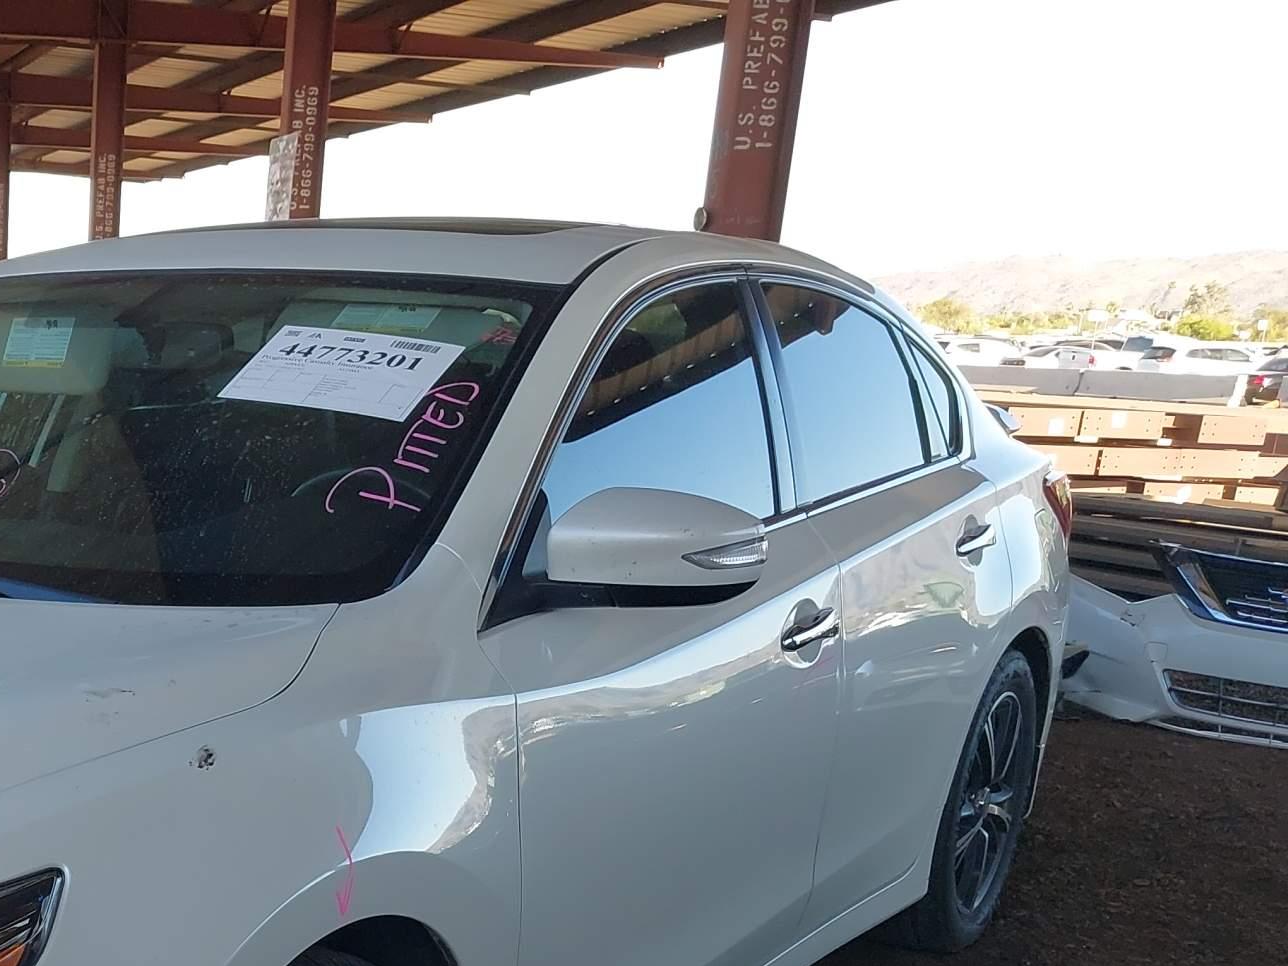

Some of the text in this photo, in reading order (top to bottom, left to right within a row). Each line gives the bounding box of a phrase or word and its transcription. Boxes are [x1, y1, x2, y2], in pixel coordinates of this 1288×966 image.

[755, 0, 792, 149] 1-866-799-
[293, 84, 307, 113] INC.
[299, 86, 319, 209] 1-866-799-0969
[734, 106, 755, 150] U.S.
[279, 342, 425, 371] 44773201
